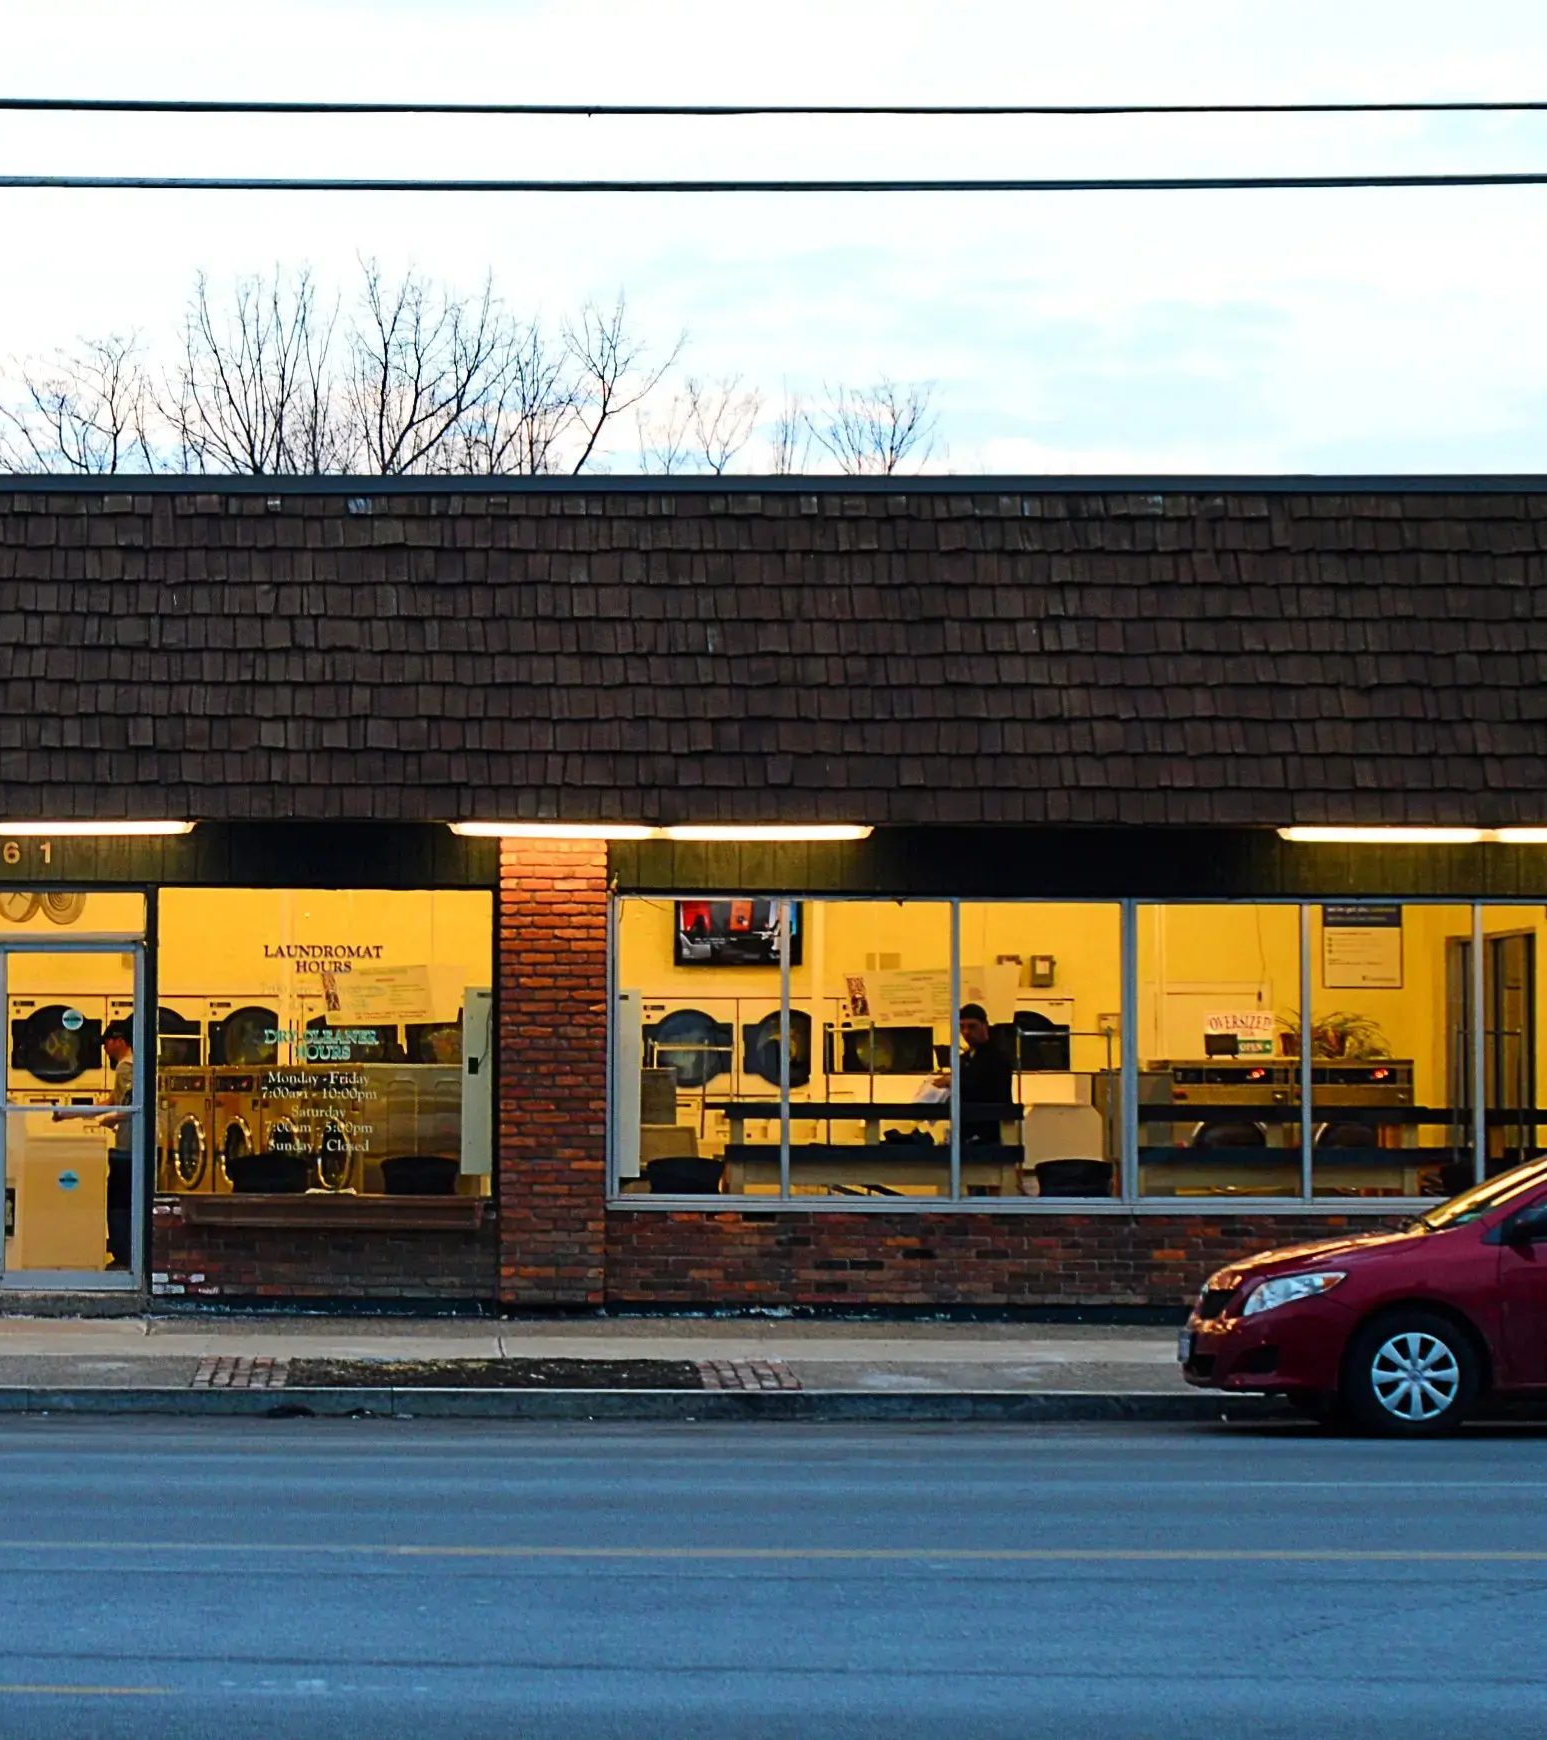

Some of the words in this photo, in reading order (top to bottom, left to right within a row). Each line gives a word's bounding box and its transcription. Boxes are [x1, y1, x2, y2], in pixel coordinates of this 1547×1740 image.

[263, 945, 383, 959] LAUNDROMAT
[295, 961, 352, 974] HOURS
[264, 1029, 297, 1044] DRY
[302, 1029, 379, 1045] CLEANER
[295, 1045, 351, 1060] HOURS
[268, 1071, 319, 1086] Monday
[329, 1072, 370, 1086] Friday
[261, 1086, 308, 1099] 7:00am
[322, 1088, 377, 1102] 10:00pm
[291, 1105, 346, 1119] Saturday
[268, 1139, 314, 1154] Sunday
[326, 1139, 370, 1152] Closed
